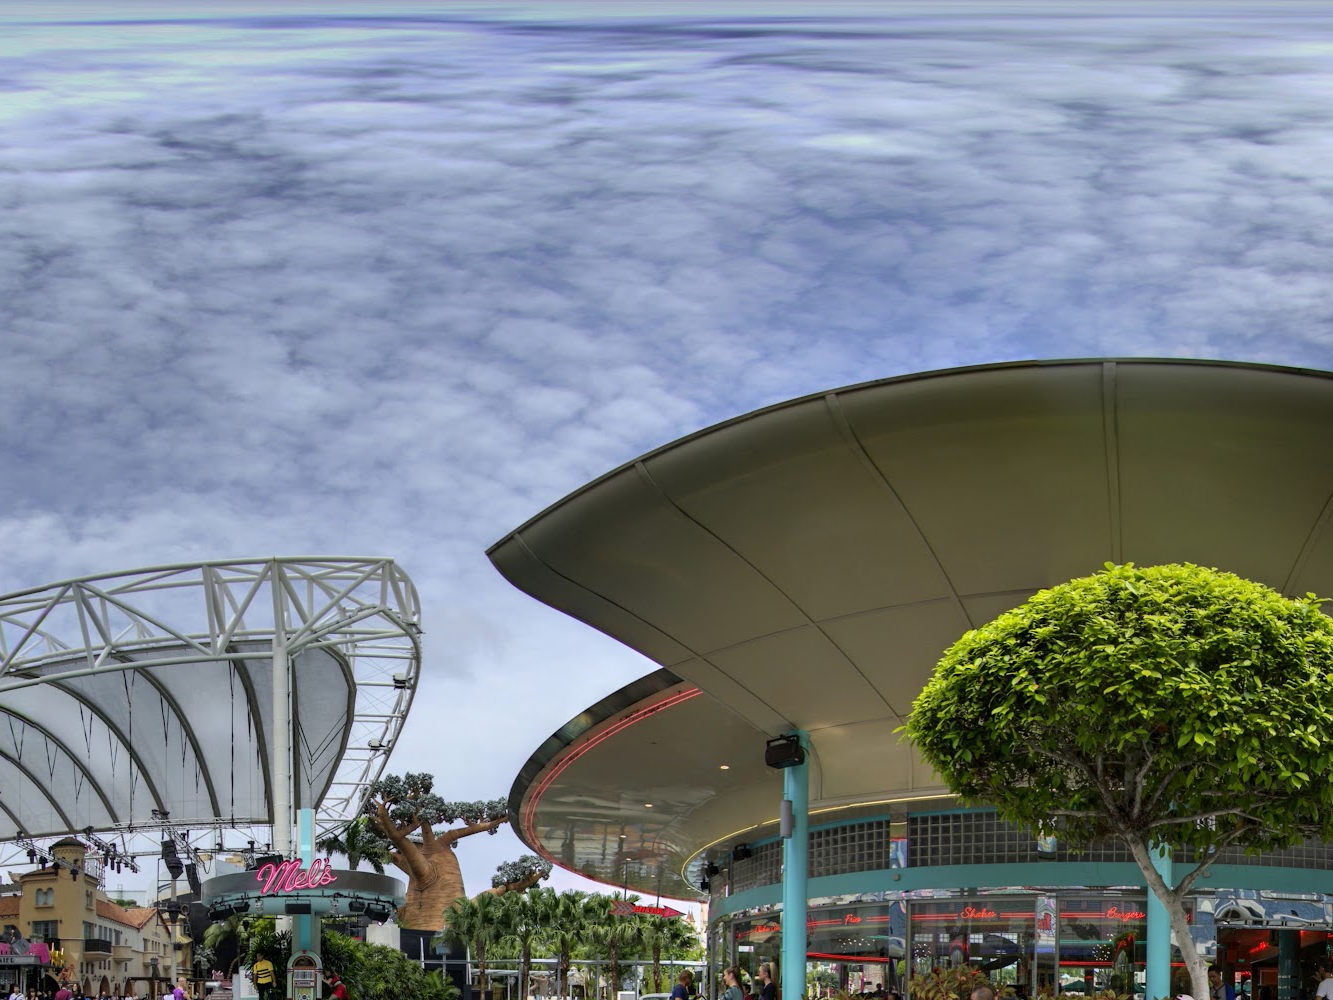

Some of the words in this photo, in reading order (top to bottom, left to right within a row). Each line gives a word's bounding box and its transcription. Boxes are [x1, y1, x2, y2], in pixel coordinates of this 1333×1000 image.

[256, 857, 338, 895] Mel's
[960, 906, 997, 919] Shakes
[1106, 907, 1146, 922] Burgers
